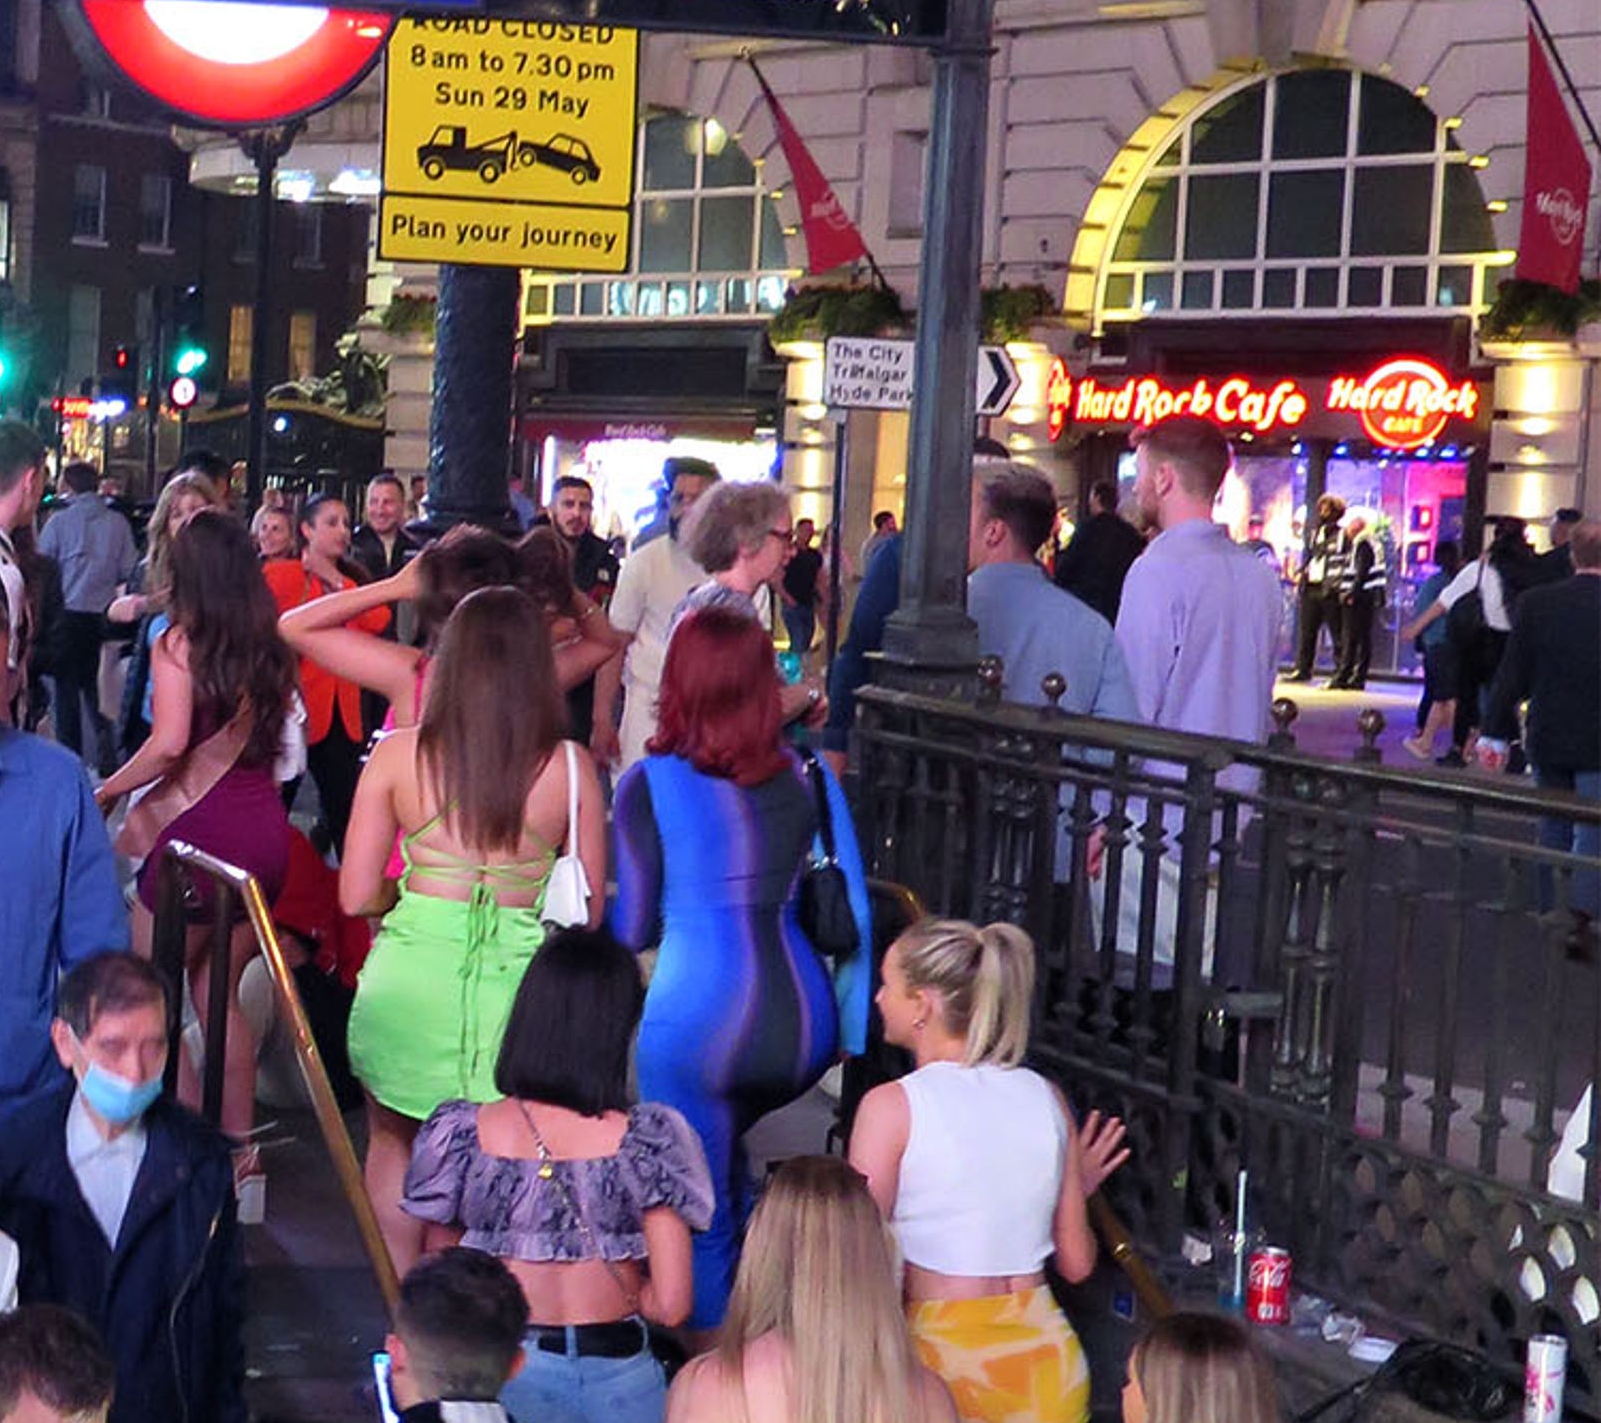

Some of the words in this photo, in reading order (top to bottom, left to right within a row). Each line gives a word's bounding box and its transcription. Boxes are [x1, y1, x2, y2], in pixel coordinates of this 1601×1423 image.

[501, 21, 615, 45] CLOSED
[479, 49, 505, 73] to
[435, 81, 484, 107] Sun
[494, 85, 528, 111] 29
[538, 89, 590, 118] May
[391, 214, 446, 240] Plan
[456, 223, 511, 245] your
[520, 221, 618, 254] journey
[833, 343, 863, 359] The
[869, 345, 904, 365] City
[829, 384, 873, 403] Hyde
[1075, 377, 1136, 421] Hard
[1214, 378, 1308, 431] Cafe
[1326, 376, 1407, 410] Hard
[1404, 378, 1479, 419] Rock
